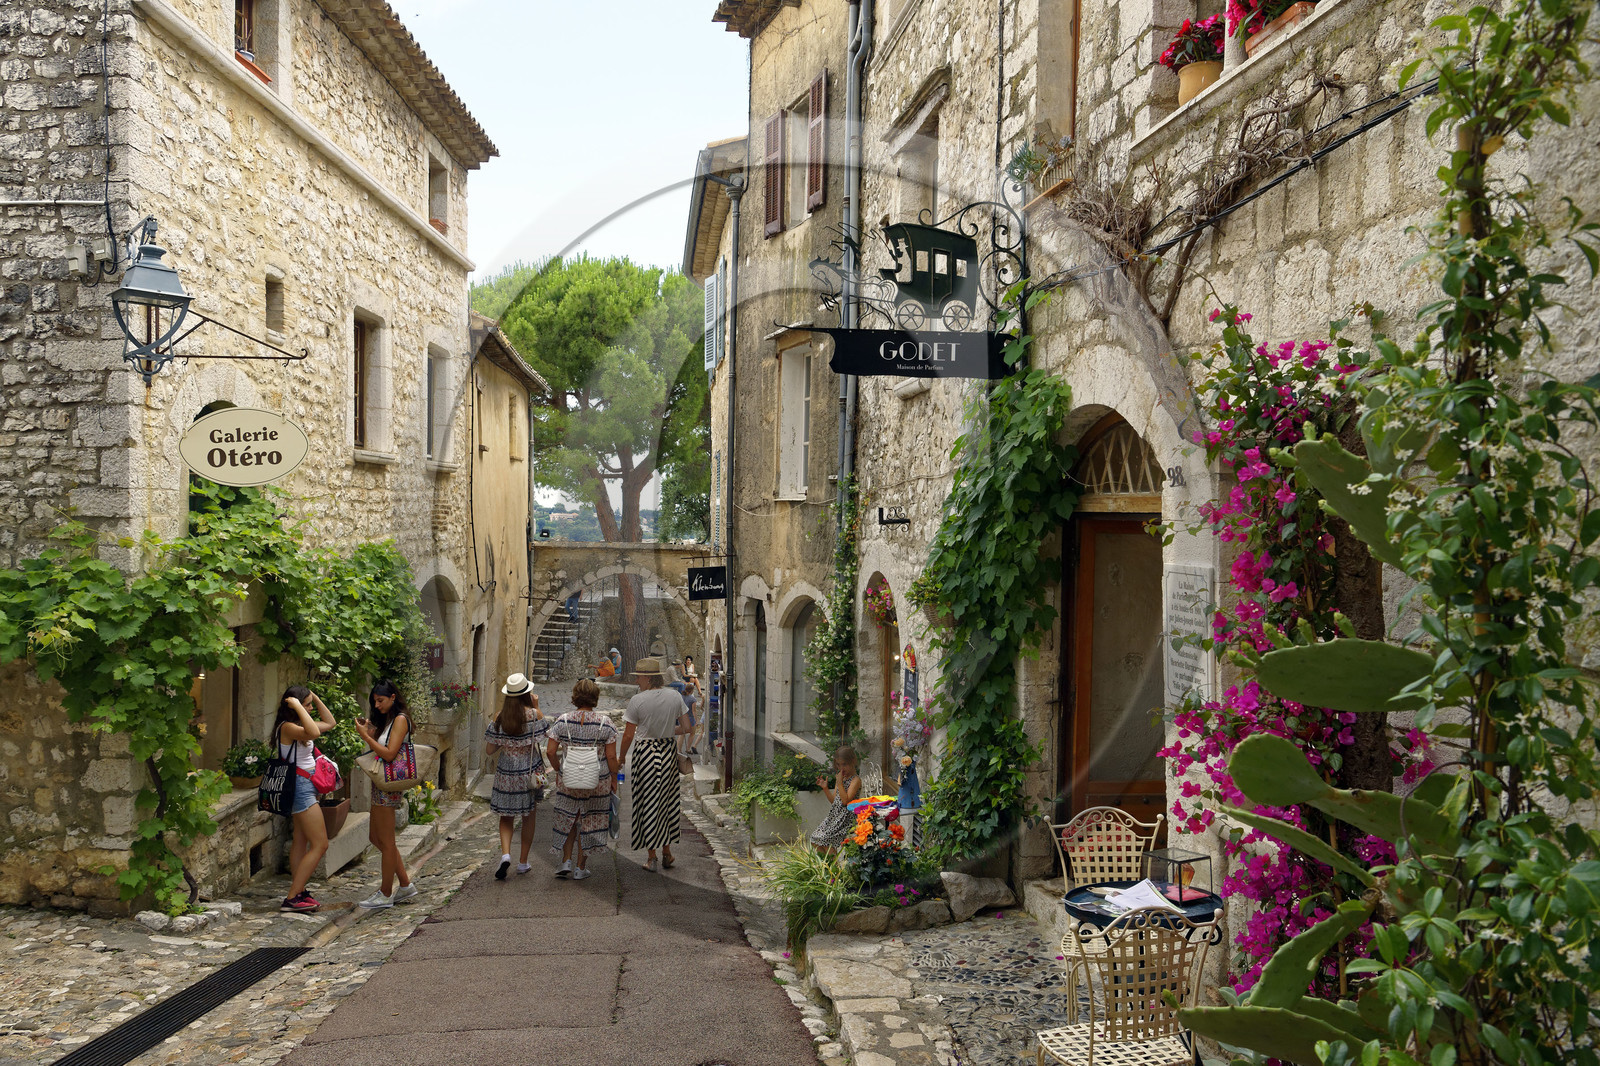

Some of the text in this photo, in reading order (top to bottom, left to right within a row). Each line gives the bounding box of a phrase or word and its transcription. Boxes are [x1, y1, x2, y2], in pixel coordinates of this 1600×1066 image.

[879, 340, 962, 362] GODET
[896, 363, 916, 371] Maison
[916, 363, 924, 371] de
[209, 426, 279, 444] Galerie
[207, 445, 283, 468] Otéro
